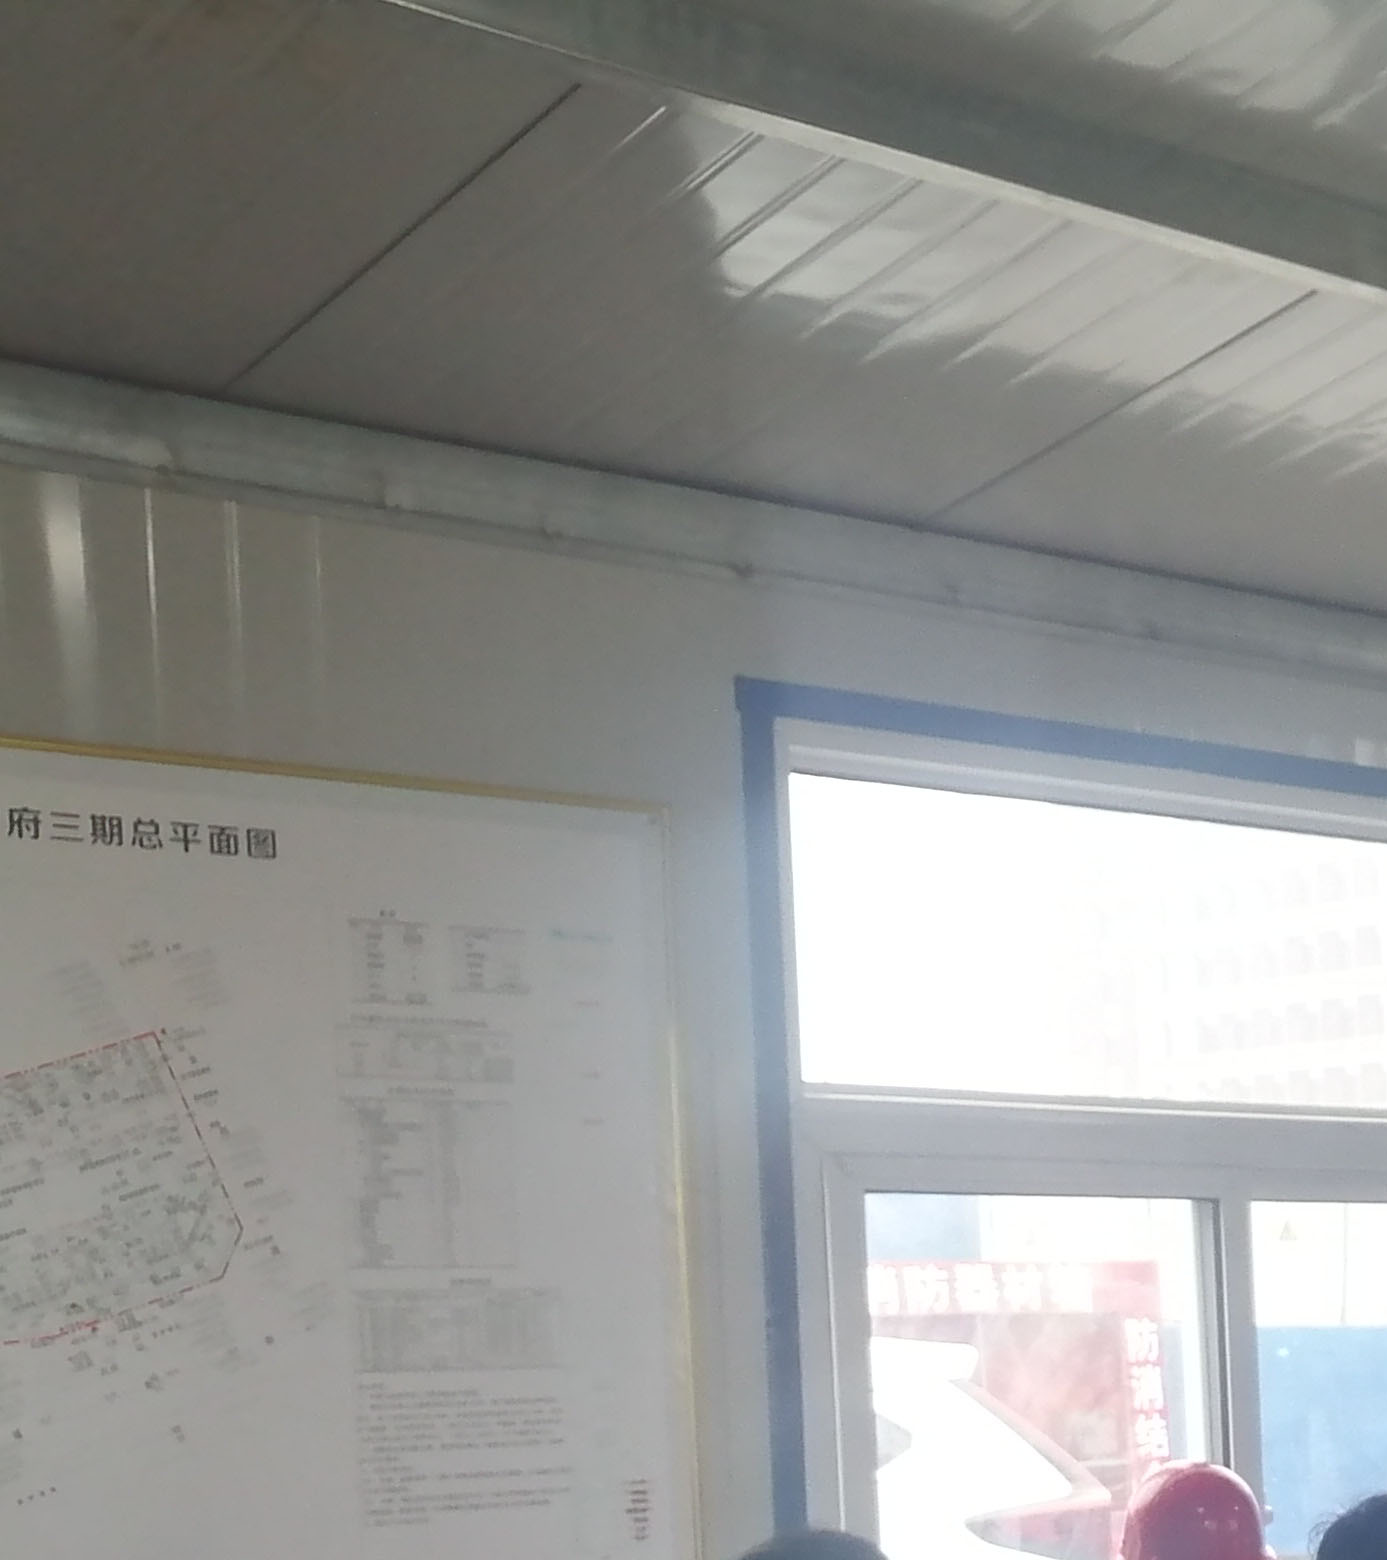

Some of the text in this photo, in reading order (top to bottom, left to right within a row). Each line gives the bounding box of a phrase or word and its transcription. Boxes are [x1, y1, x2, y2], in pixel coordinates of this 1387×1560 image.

[7, 807, 278, 860] 府三期总平面图
